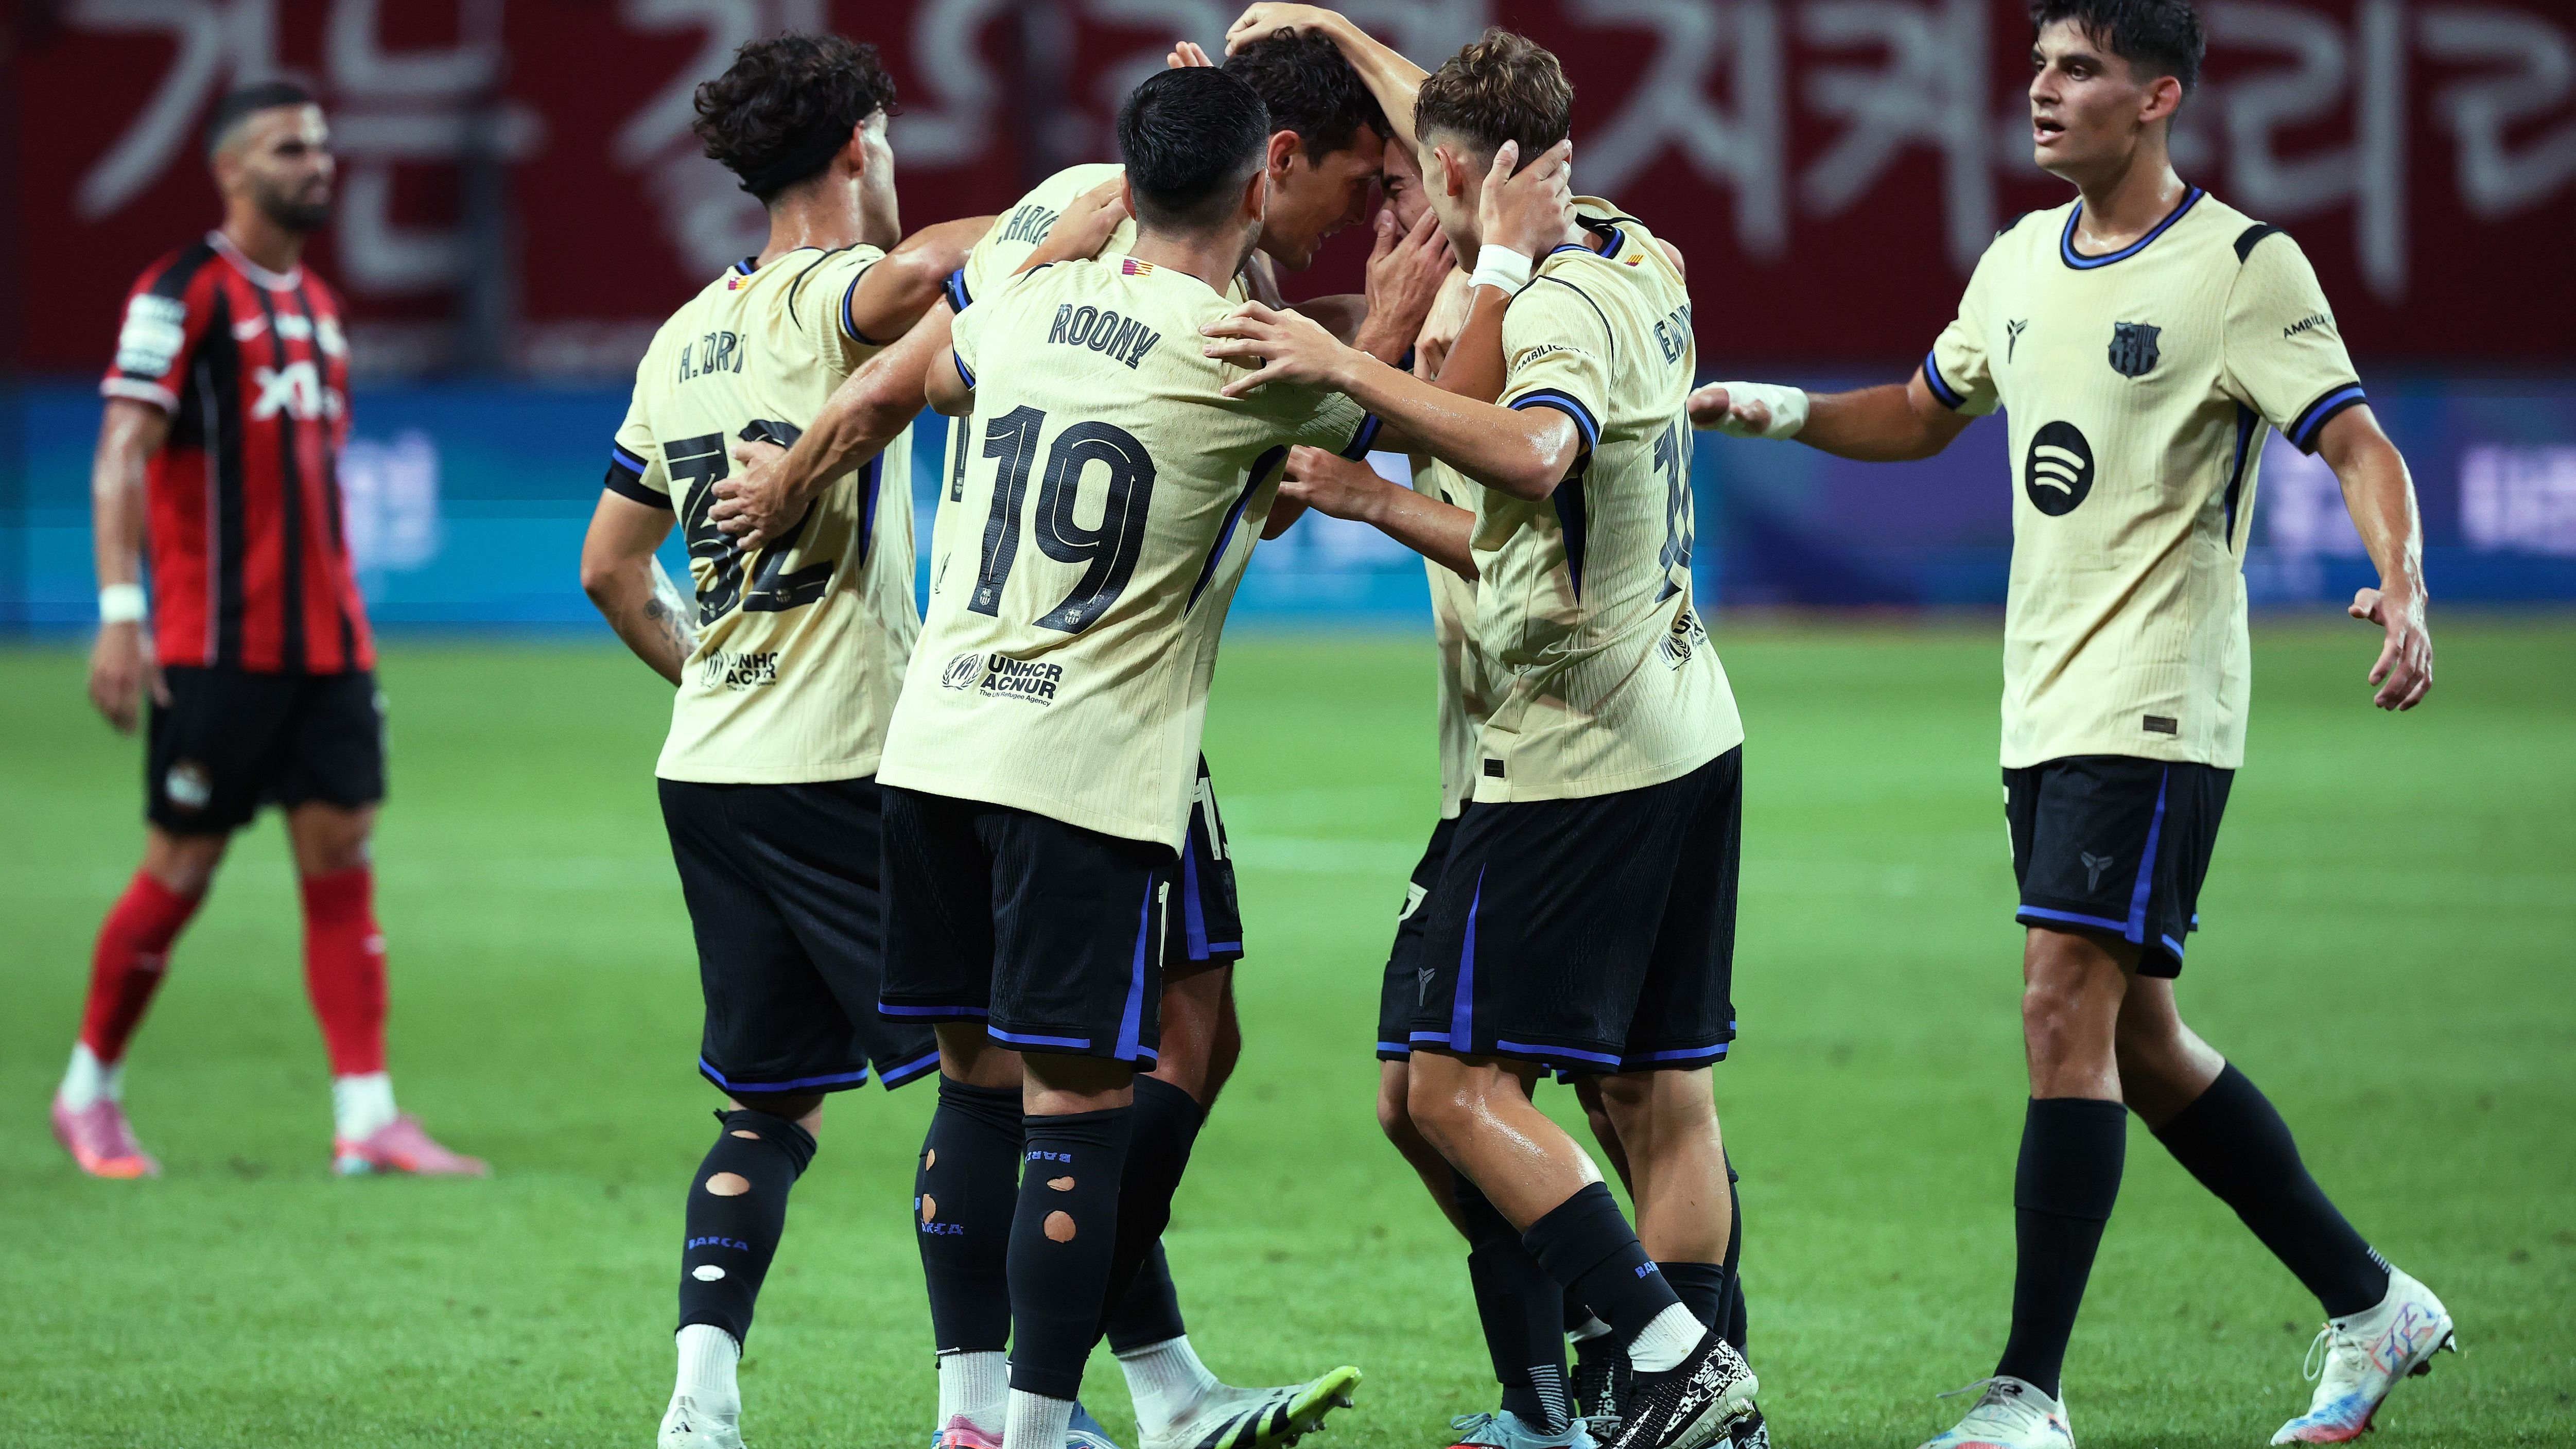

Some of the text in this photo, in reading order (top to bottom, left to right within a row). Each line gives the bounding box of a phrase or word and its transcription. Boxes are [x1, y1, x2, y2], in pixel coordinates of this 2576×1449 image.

[1048, 304, 1161, 369] ROONY
[2283, 313, 2331, 339] AMBILI
[967, 405, 1158, 635] 19
[988, 654, 1062, 682] UNHCR
[981, 673, 1056, 699] ACNUR
[1000, 691, 1025, 700] Refugee
[1025, 695, 1051, 707] Agency
